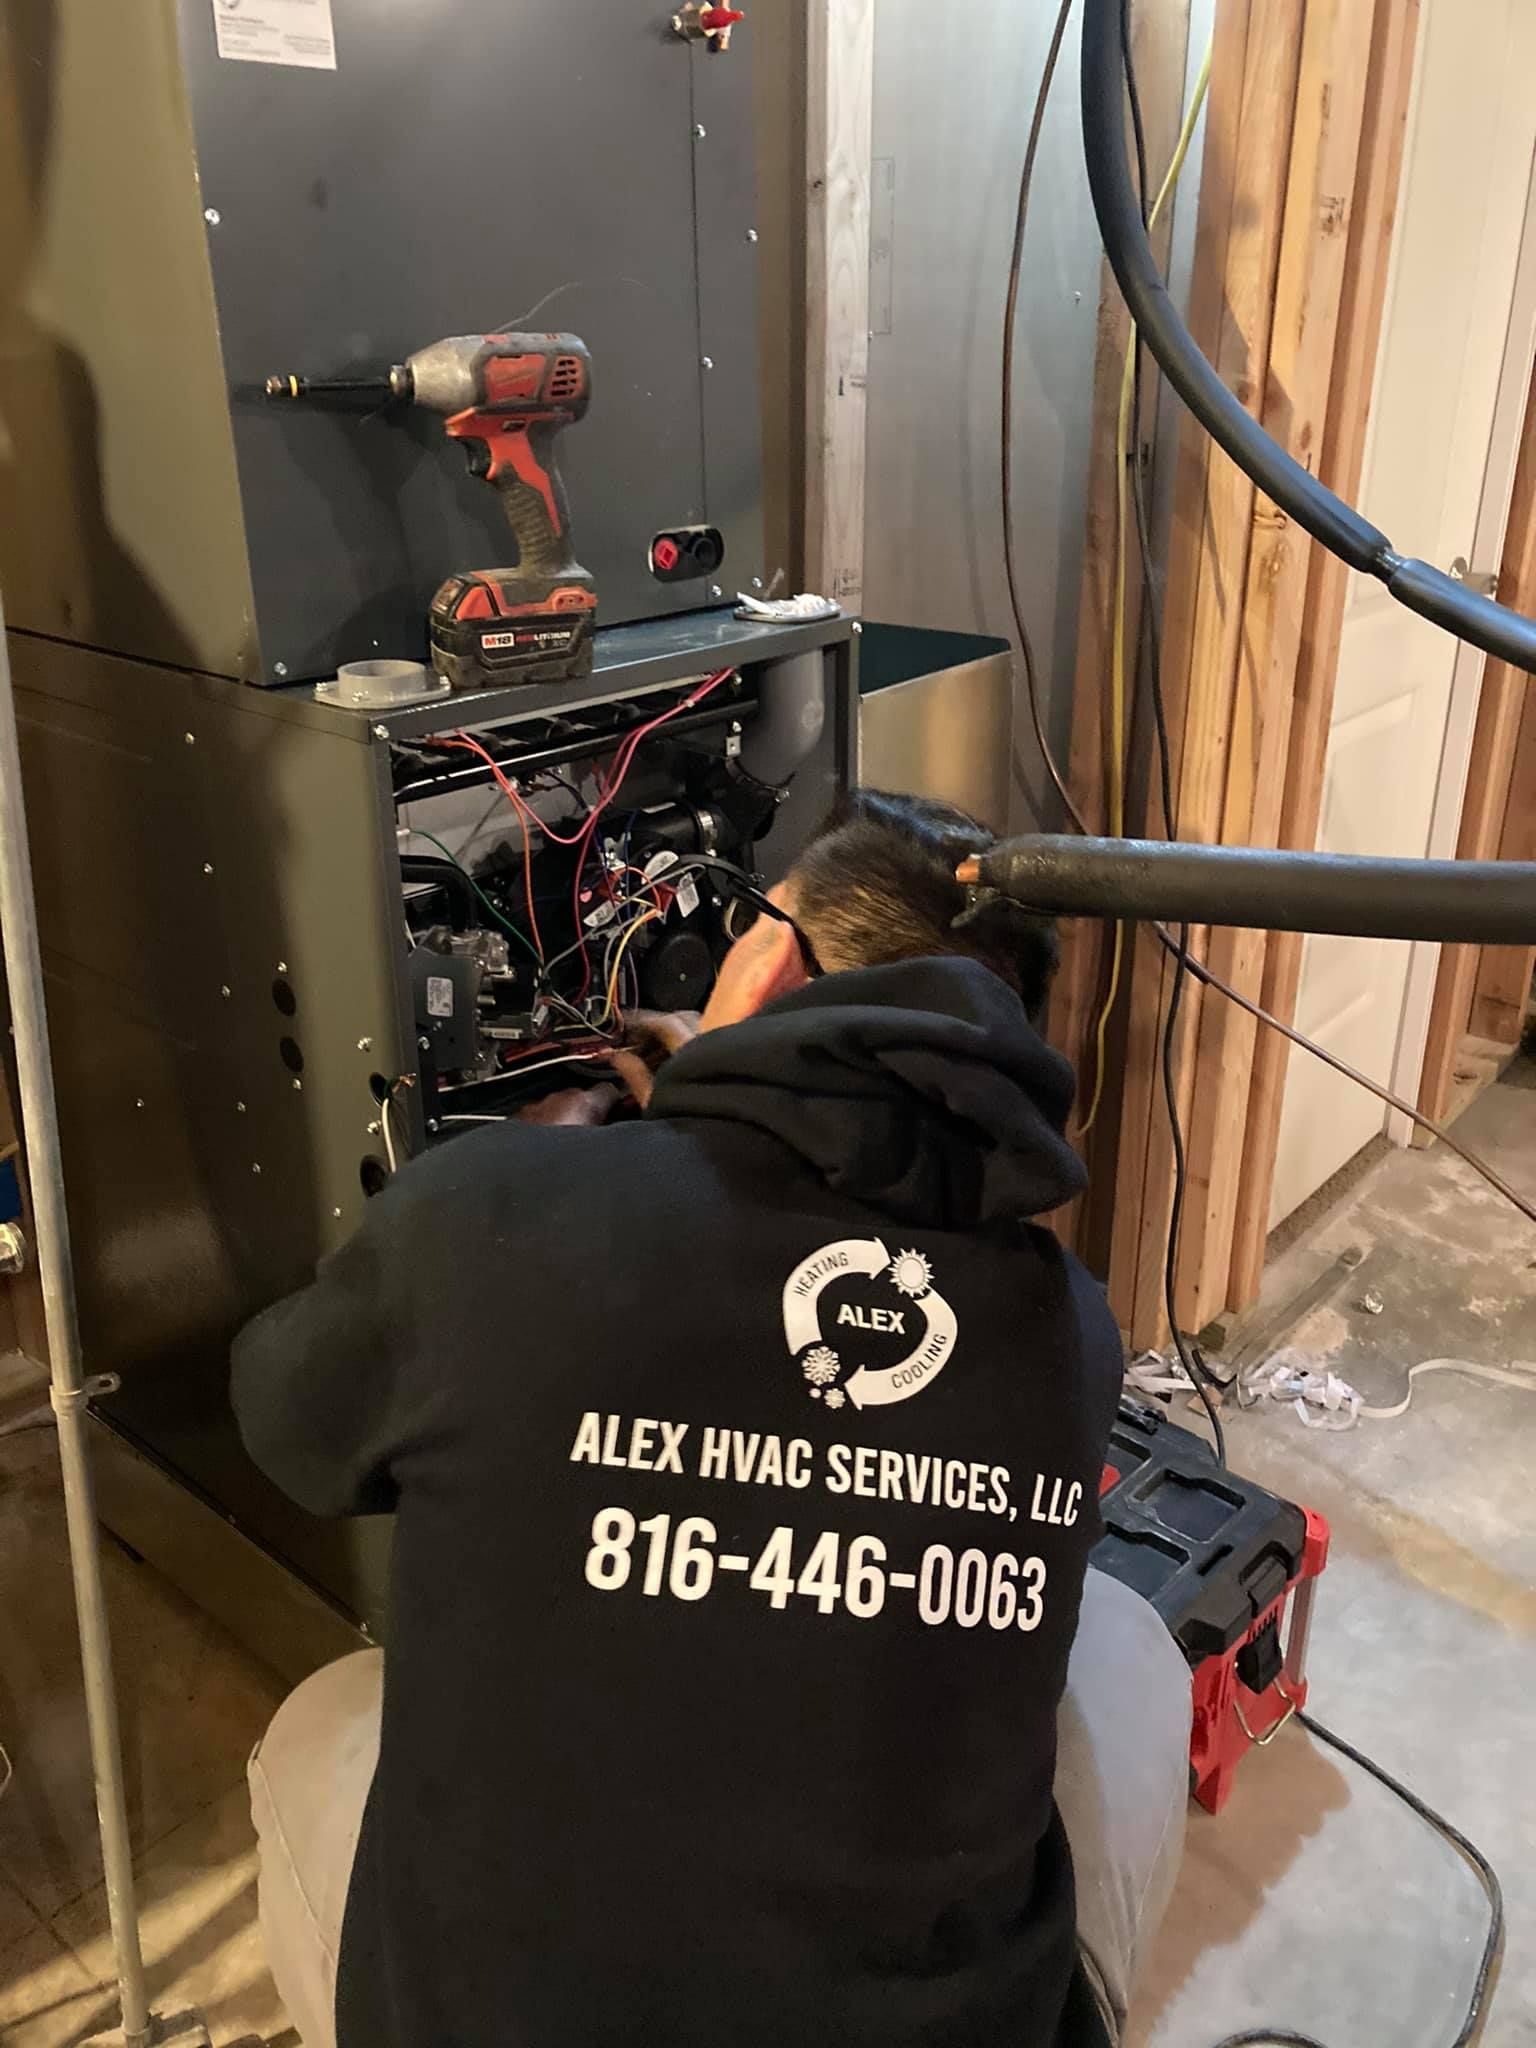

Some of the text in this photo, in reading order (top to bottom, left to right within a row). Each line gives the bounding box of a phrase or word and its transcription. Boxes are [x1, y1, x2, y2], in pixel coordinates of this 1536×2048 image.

[484, 636, 512, 646] M18
[794, 1252, 849, 1297] HEATING
[836, 1304, 906, 1335] ALEX
[891, 1333, 947, 1389] COOLING
[570, 1412, 1082, 1527] ALEX HVAC SERVICES, LLC
[585, 1507, 1047, 1632] 816-446-0063
